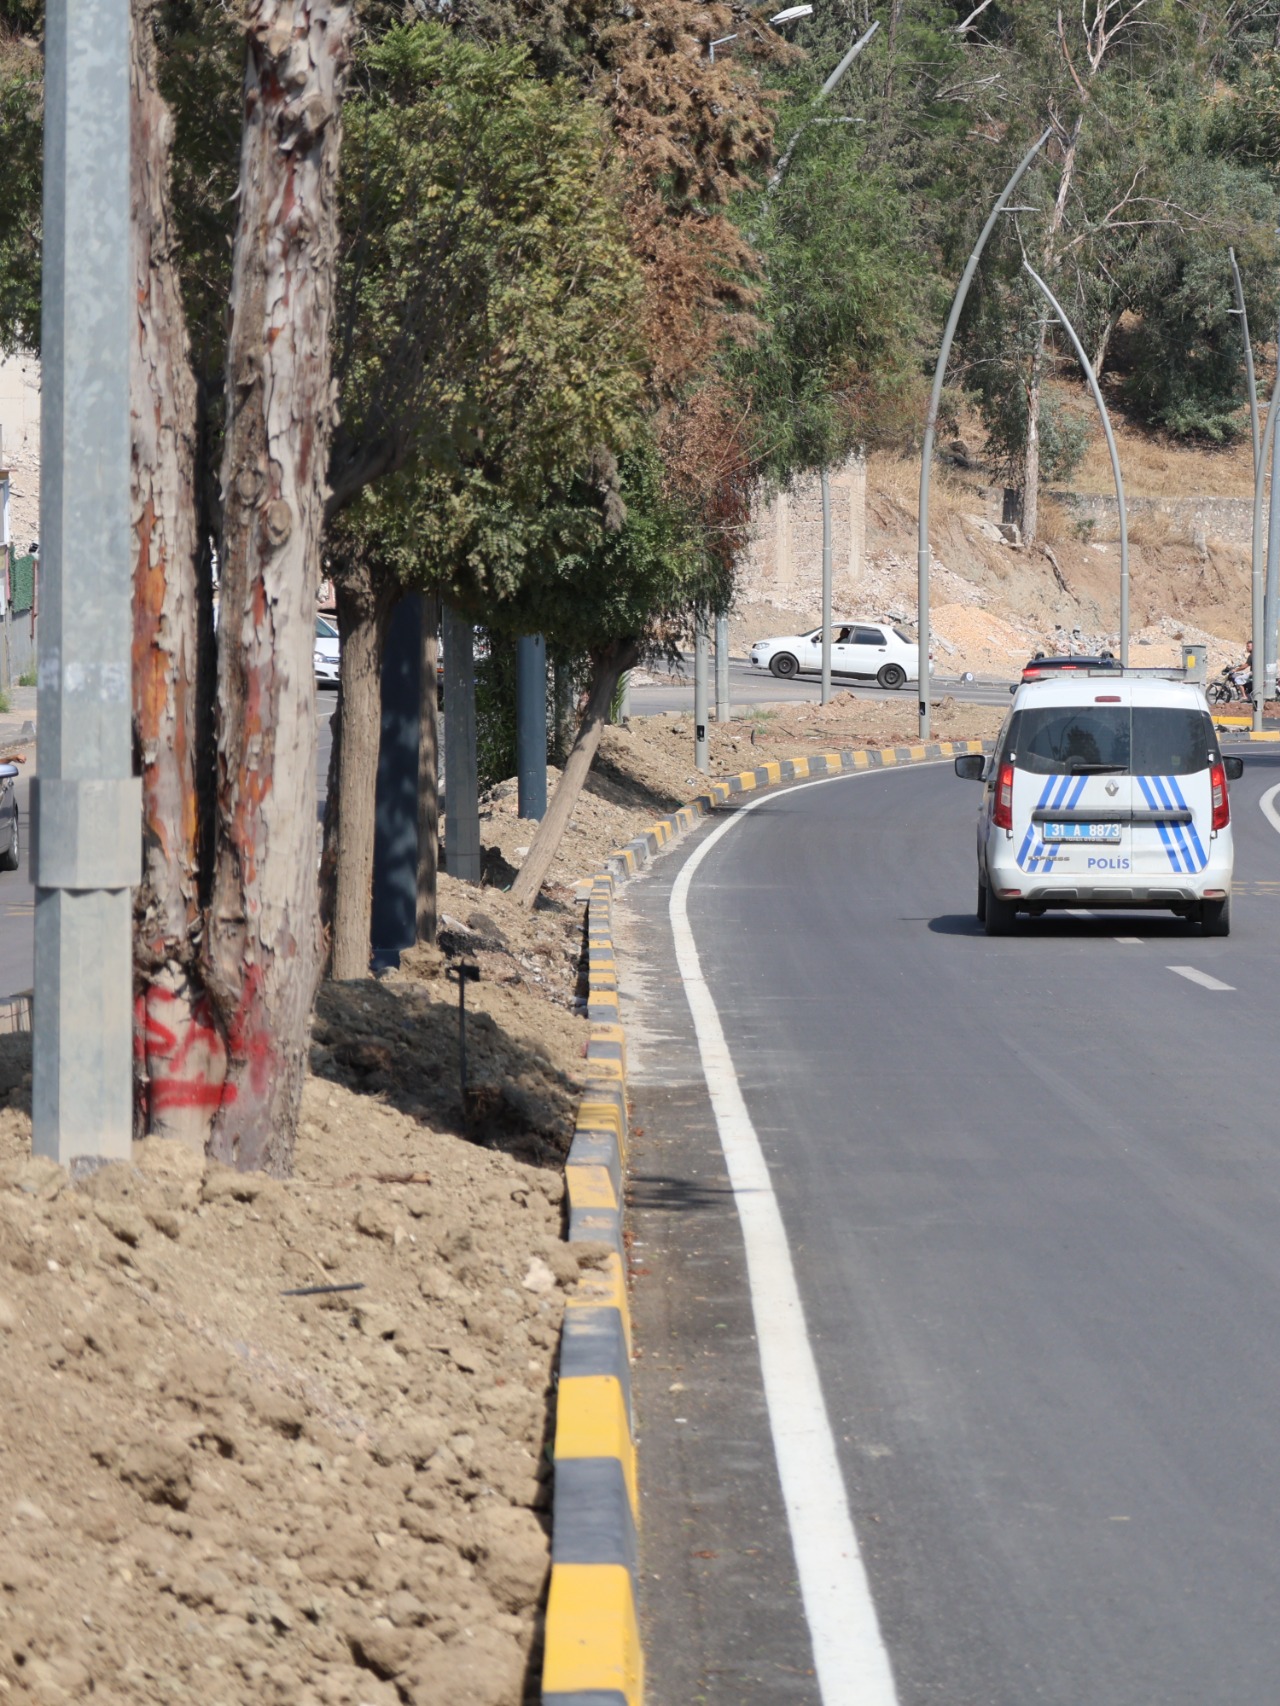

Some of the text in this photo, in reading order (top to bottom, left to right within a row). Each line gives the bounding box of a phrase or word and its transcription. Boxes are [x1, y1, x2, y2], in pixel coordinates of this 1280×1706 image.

[1052, 824, 1119, 836] 31 A 8873
[1088, 855, 1130, 869] POLİS
